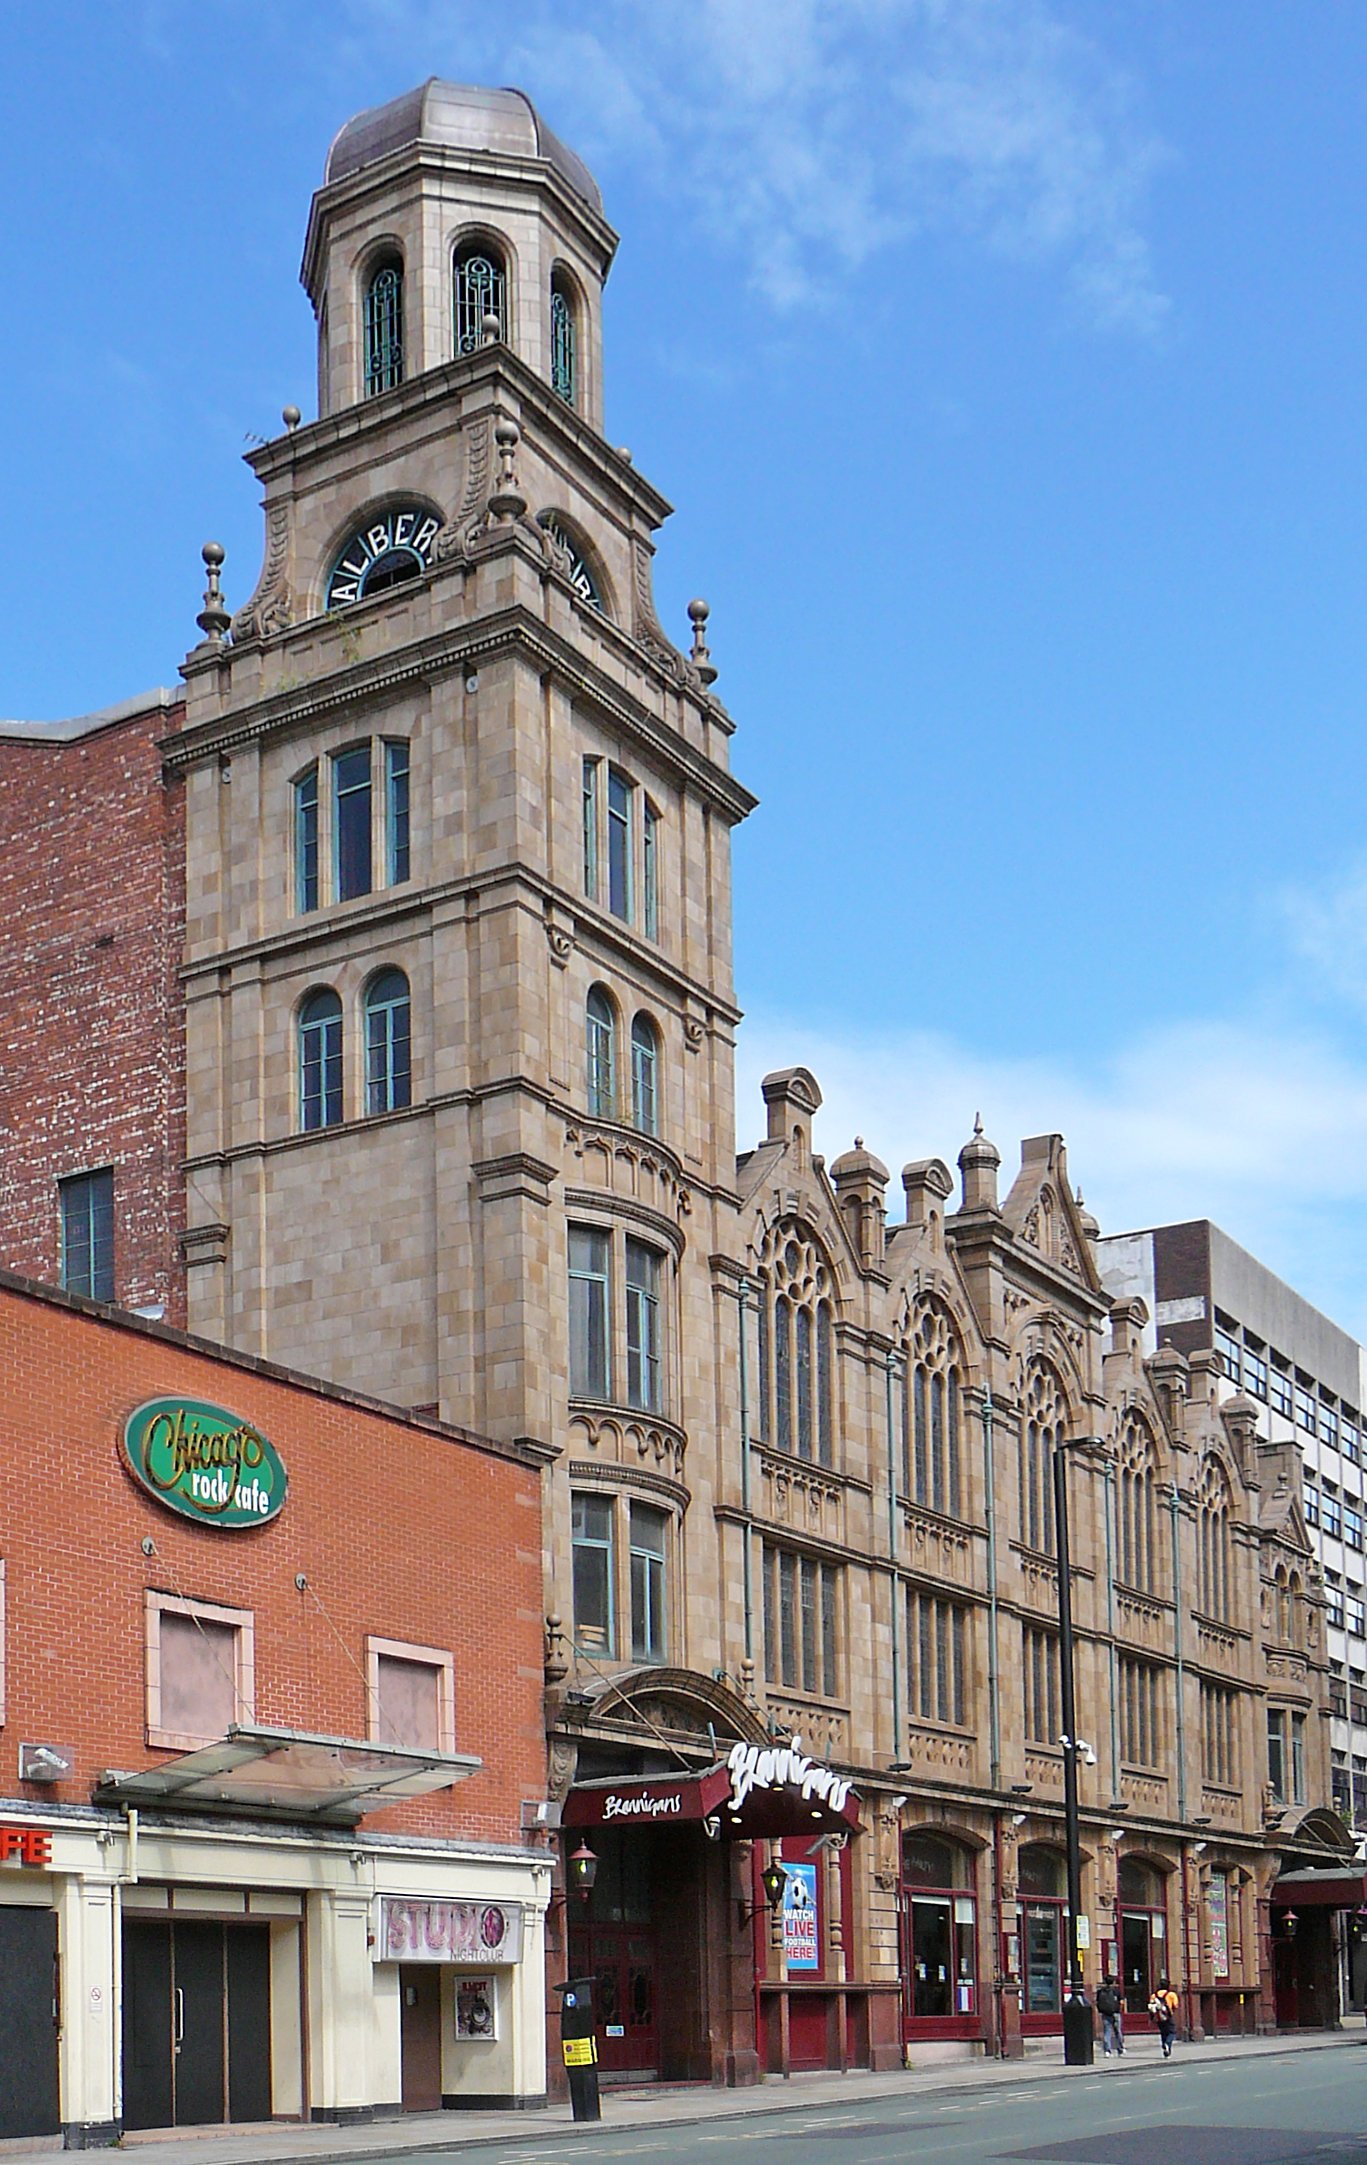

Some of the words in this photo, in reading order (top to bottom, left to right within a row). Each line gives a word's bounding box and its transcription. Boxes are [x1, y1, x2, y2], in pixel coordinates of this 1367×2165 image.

[331, 514, 439, 601] ALBER
[145, 1409, 264, 1514] Chicago
[192, 1469, 230, 1502] rock
[234, 1478, 270, 1514] cafe
[783, 1909, 814, 1920] WATCH
[785, 1921, 815, 1936] LIVE
